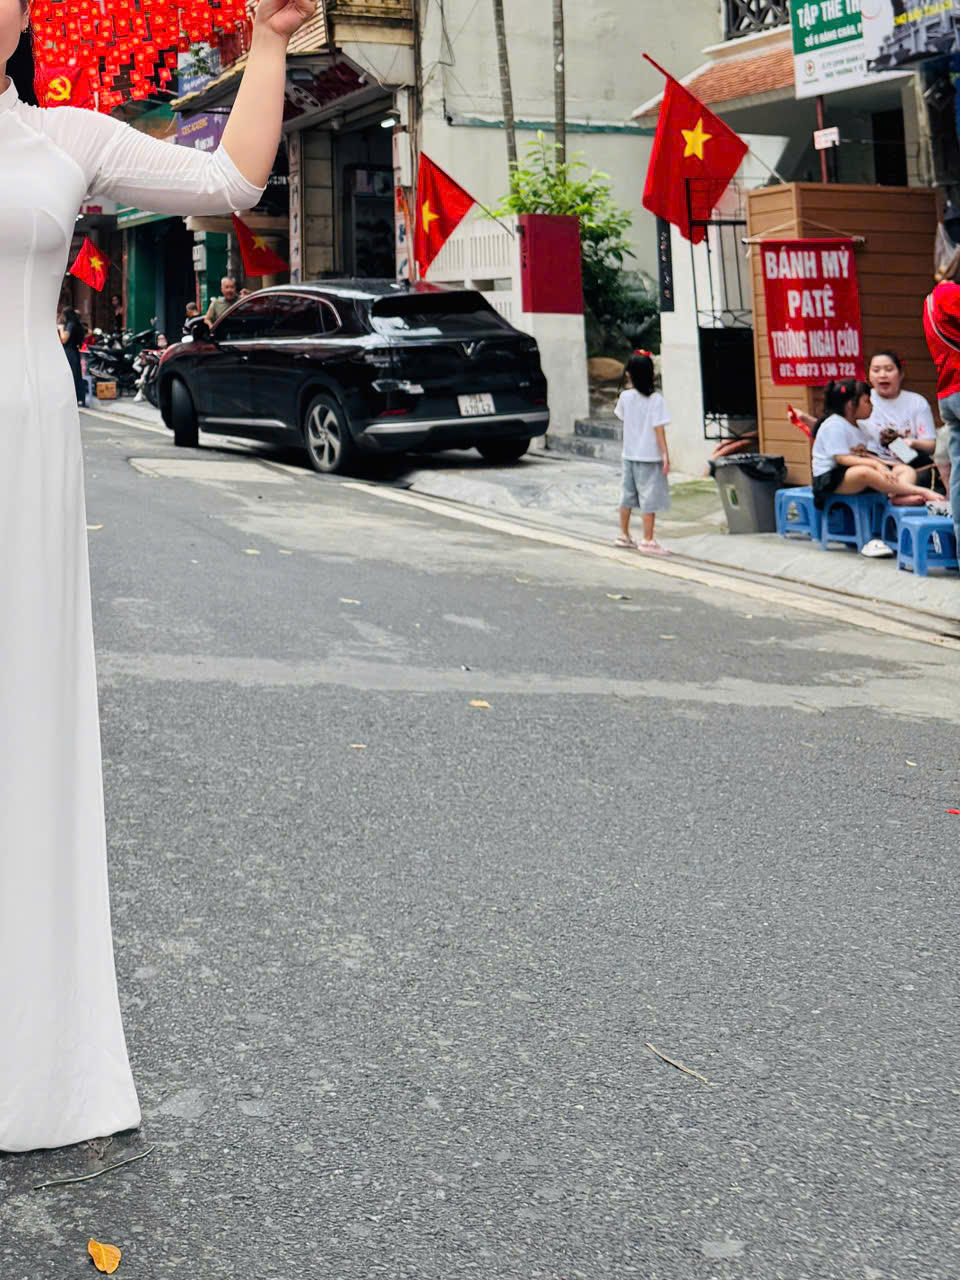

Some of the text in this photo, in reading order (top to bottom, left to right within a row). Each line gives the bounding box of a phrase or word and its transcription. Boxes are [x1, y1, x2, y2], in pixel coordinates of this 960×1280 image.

[764, 245, 817, 279] BÁNH
[787, 283, 835, 318] PATÊ
[771, 322, 808, 358] TRỨNG
[837, 321, 859, 357] CỨU
